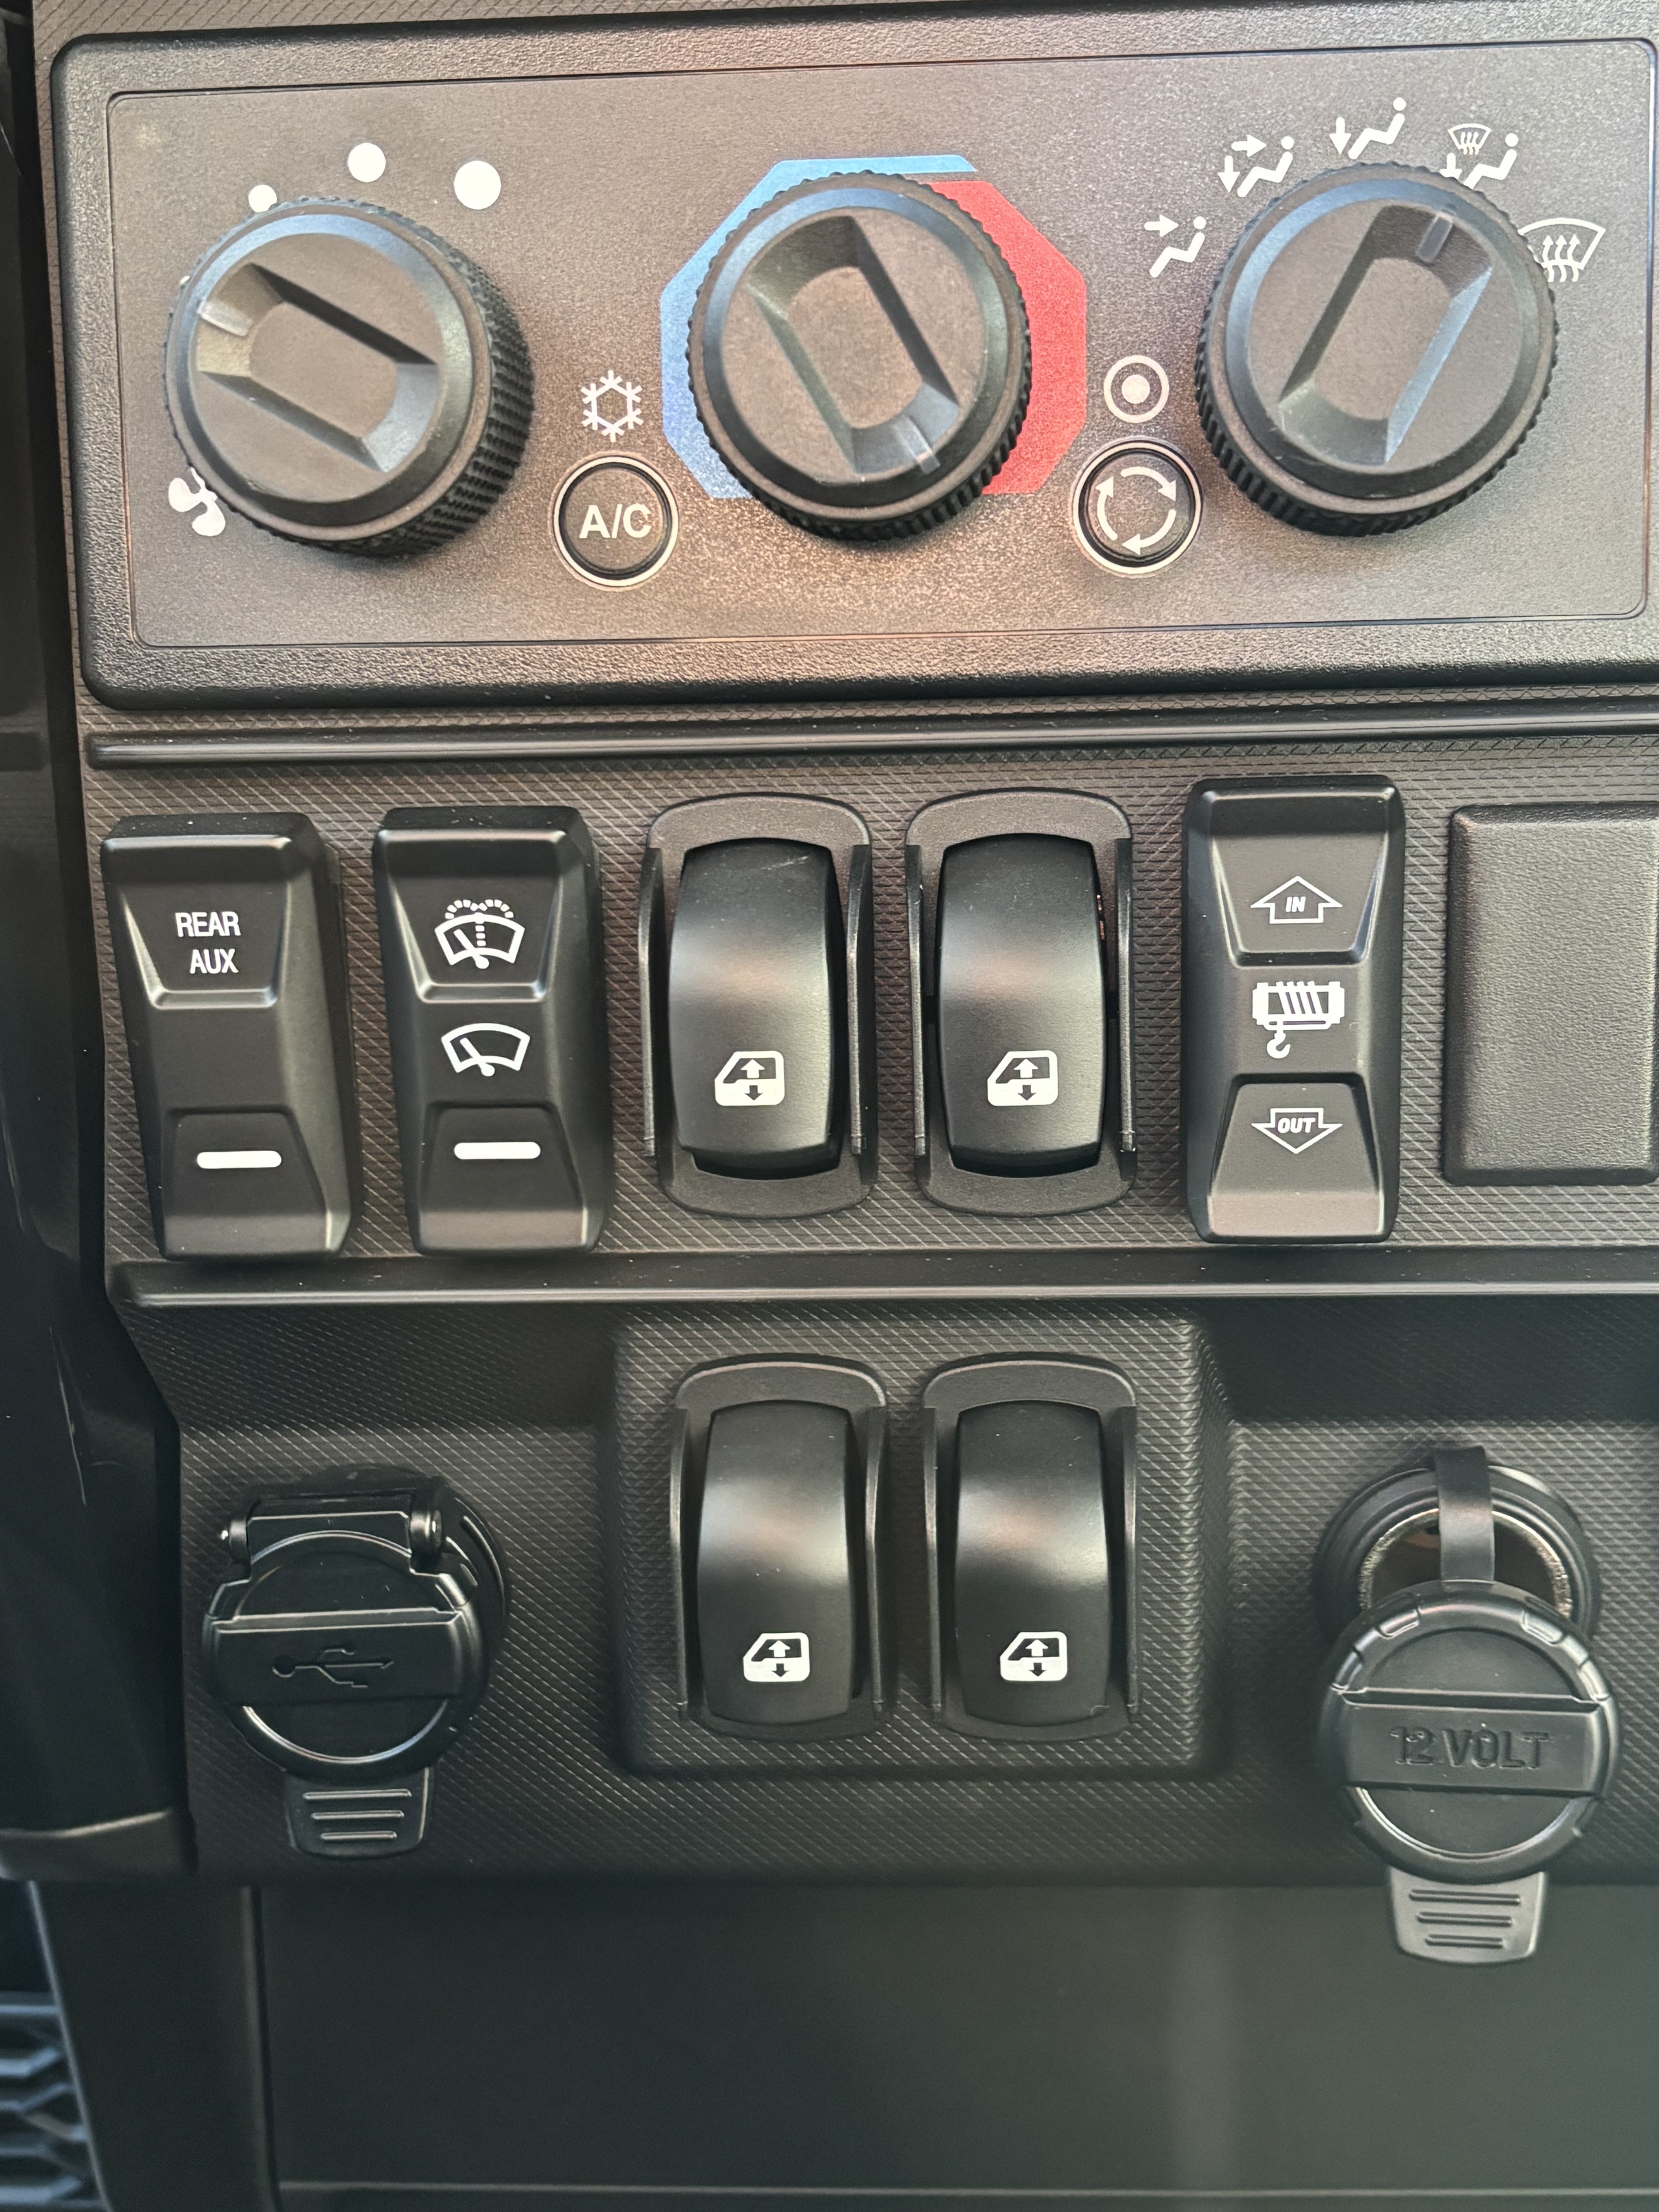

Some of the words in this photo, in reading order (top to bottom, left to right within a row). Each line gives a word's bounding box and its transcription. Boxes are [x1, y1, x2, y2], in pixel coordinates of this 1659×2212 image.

[579, 504, 652, 539] A/C
[1285, 896, 1306, 912] IN
[175, 911, 241, 938] REAR
[189, 948, 239, 974] AUX
[1278, 1117, 1316, 1134] OUT
[1391, 1726, 1434, 1765] 12
[1441, 1728, 1549, 1770] VOLT
